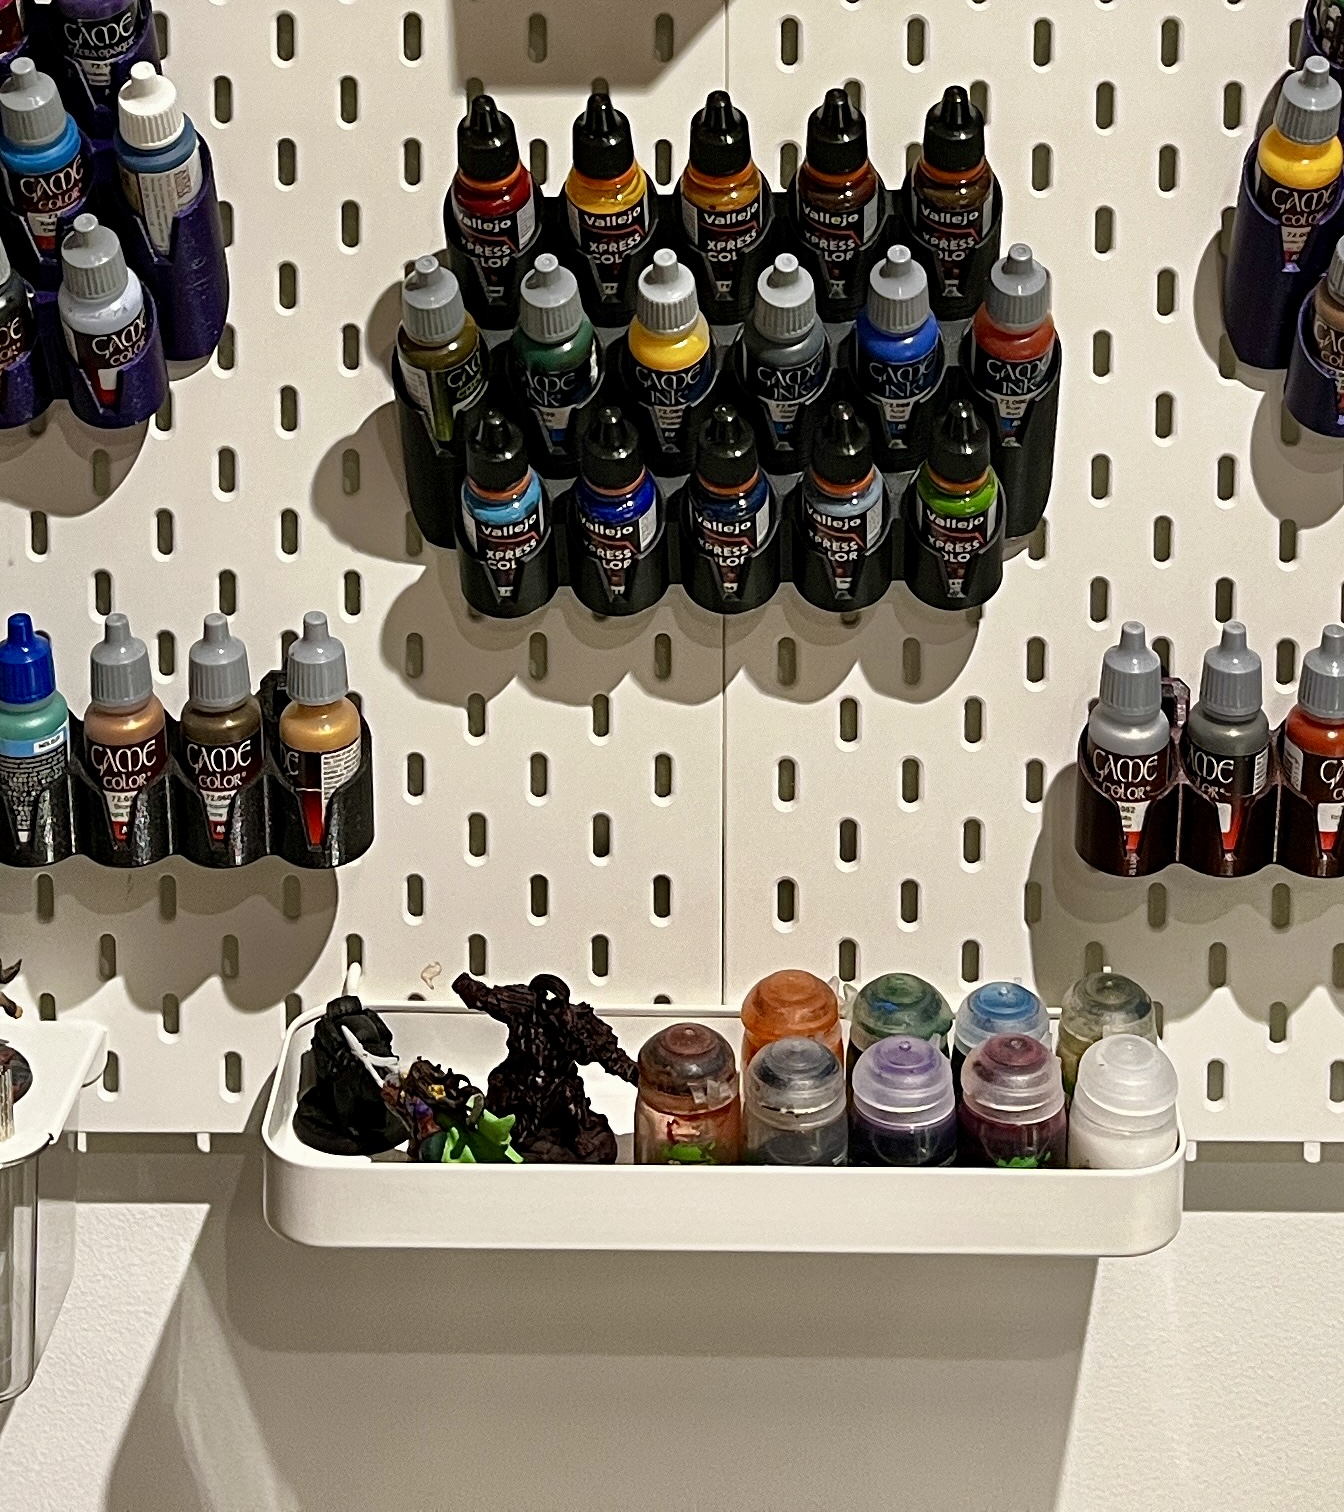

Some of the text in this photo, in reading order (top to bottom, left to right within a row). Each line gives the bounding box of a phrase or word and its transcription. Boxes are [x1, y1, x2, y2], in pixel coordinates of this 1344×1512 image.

[64, 13, 135, 49] GAME
[20, 155, 83, 203] GAME
[39, 186, 81, 212] COLOR
[584, 206, 641, 227] Vallejo
[704, 203, 758, 225] Vallejo
[803, 202, 859, 227] Vallejo
[921, 204, 979, 225] Vallejo
[589, 233, 641, 252] XPRESS
[707, 229, 757, 251] XPRESS
[480, 256, 509, 267] LOR
[592, 250, 631, 264] COL
[708, 251, 737, 262] COL
[825, 251, 854, 261] LOR
[526, 373, 575, 392] AME
[636, 364, 701, 392] GAME
[1002, 380, 1041, 395] INK
[651, 389, 684, 405] INK
[774, 383, 806, 400] INK
[885, 381, 920, 397] INK
[480, 514, 537, 537] Vallejo
[580, 515, 633, 538] Vallejo
[695, 511, 751, 534] Vallejo
[807, 504, 861, 531] Vallejo
[927, 509, 984, 530] Vallejo
[486, 538, 537, 560] XPRESS
[828, 551, 858, 561] LOR
[488, 560, 517, 570] COL
[602, 559, 631, 569] LOR
[91, 739, 156, 776] GAME
[186, 739, 252, 775] GAME
[1093, 748, 1158, 783] GAME
[103, 774, 146, 790] COLOR
[199, 772, 242, 789] COLOR
[1102, 783, 1145, 799] COLOR
